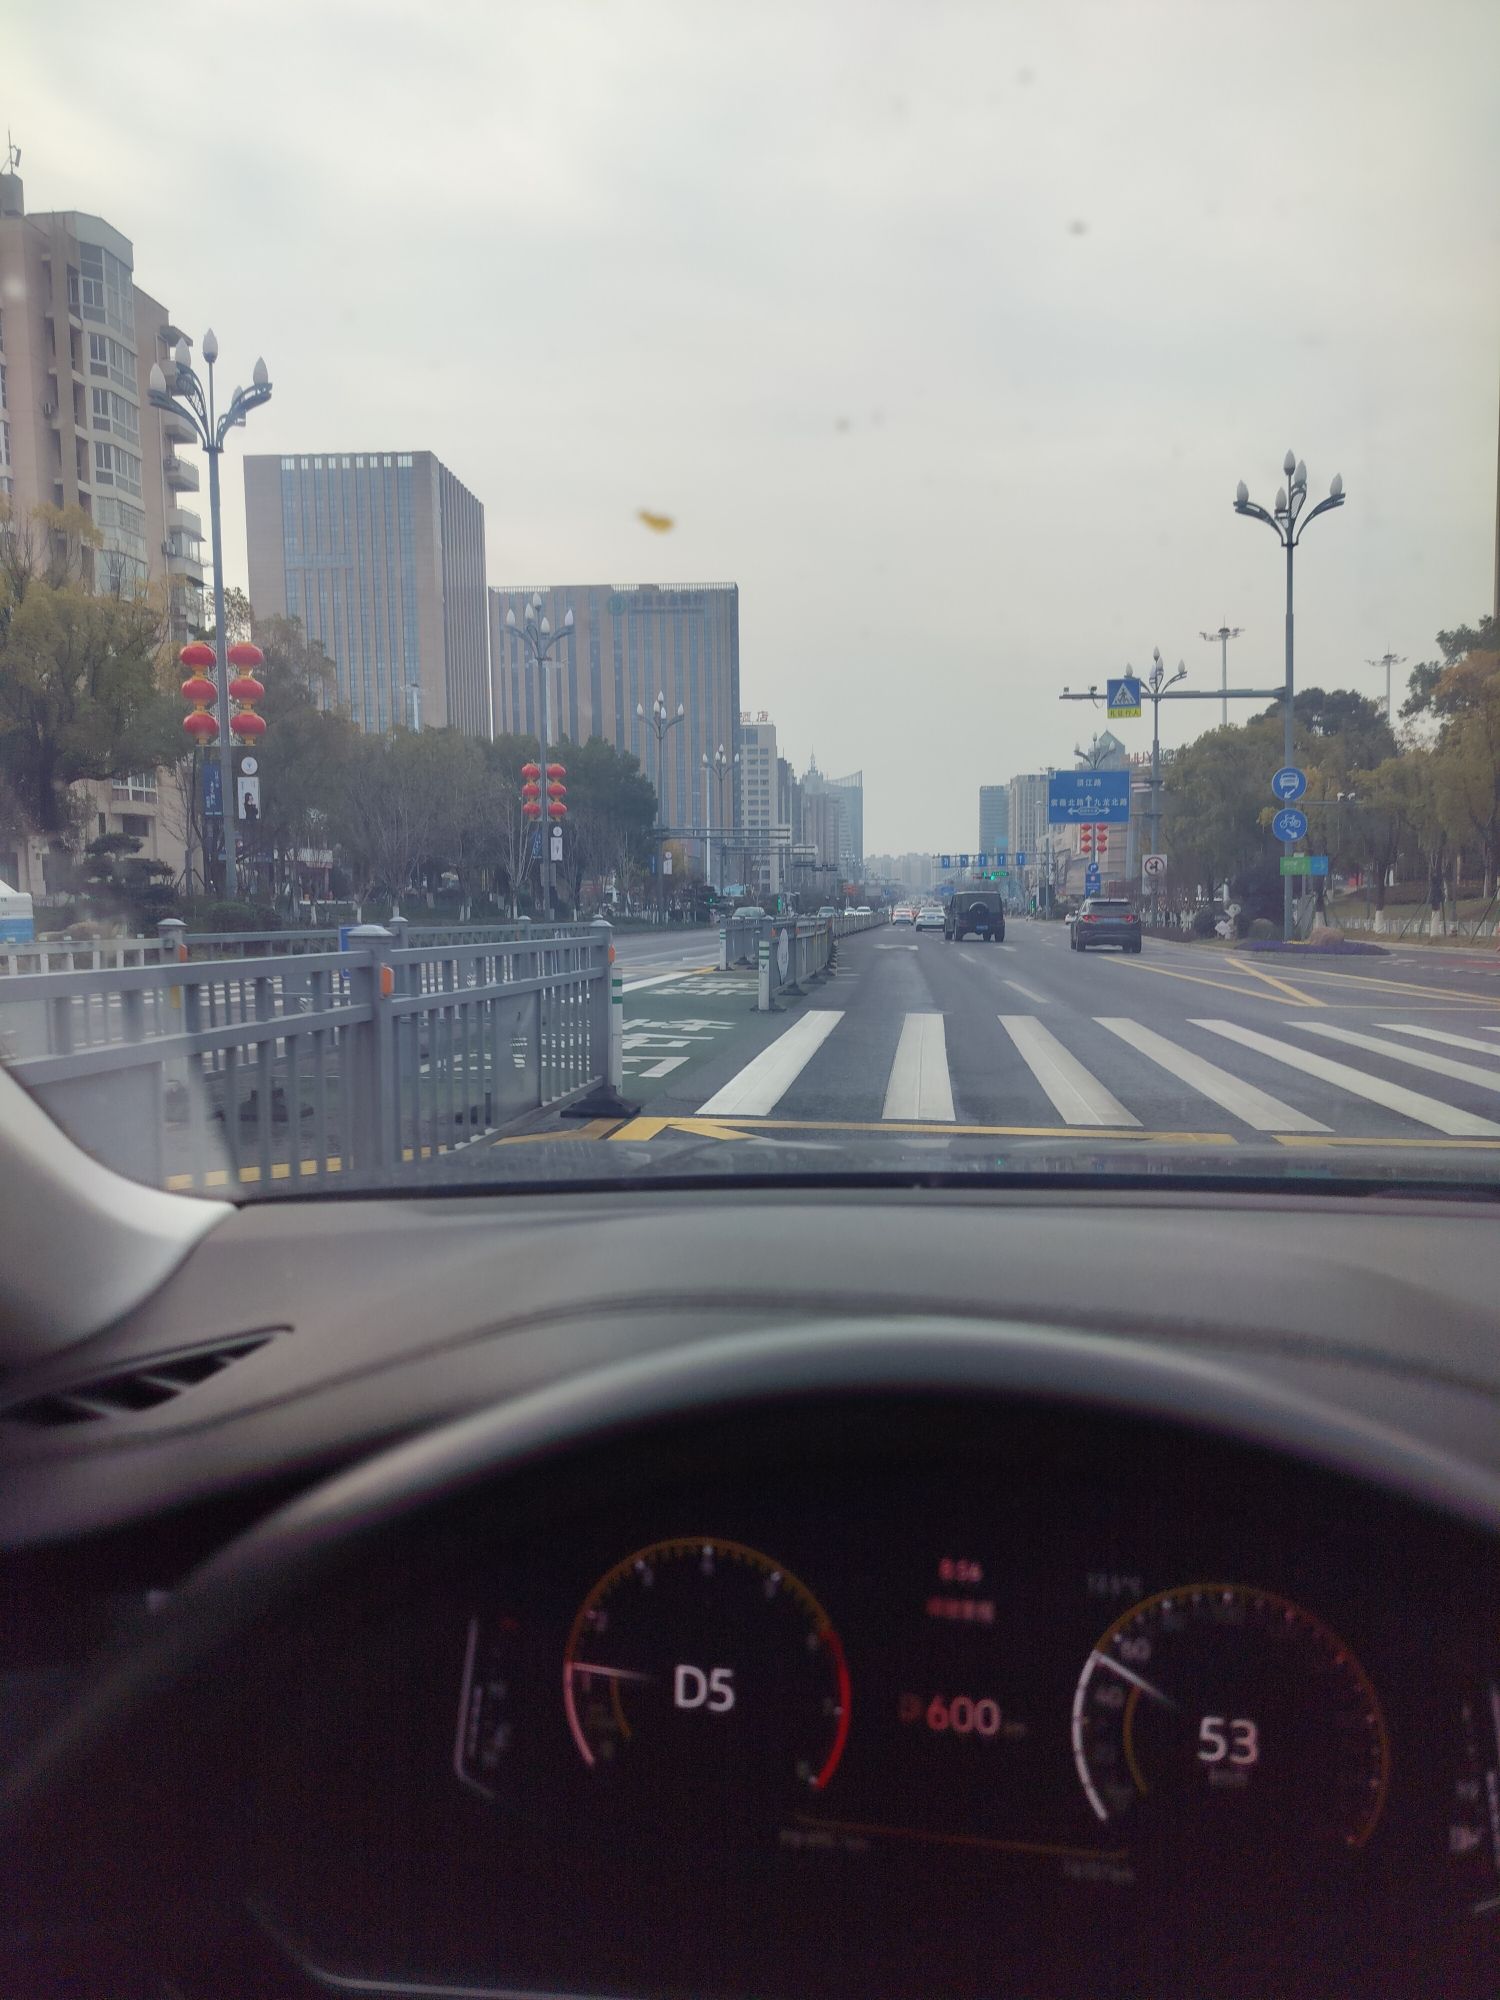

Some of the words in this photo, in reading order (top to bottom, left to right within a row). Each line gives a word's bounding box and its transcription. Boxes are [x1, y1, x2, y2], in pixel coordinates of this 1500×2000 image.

[674, 1664, 737, 1713] D5
[927, 1694, 1002, 1737] 600
[1198, 1716, 1259, 1765] 53
